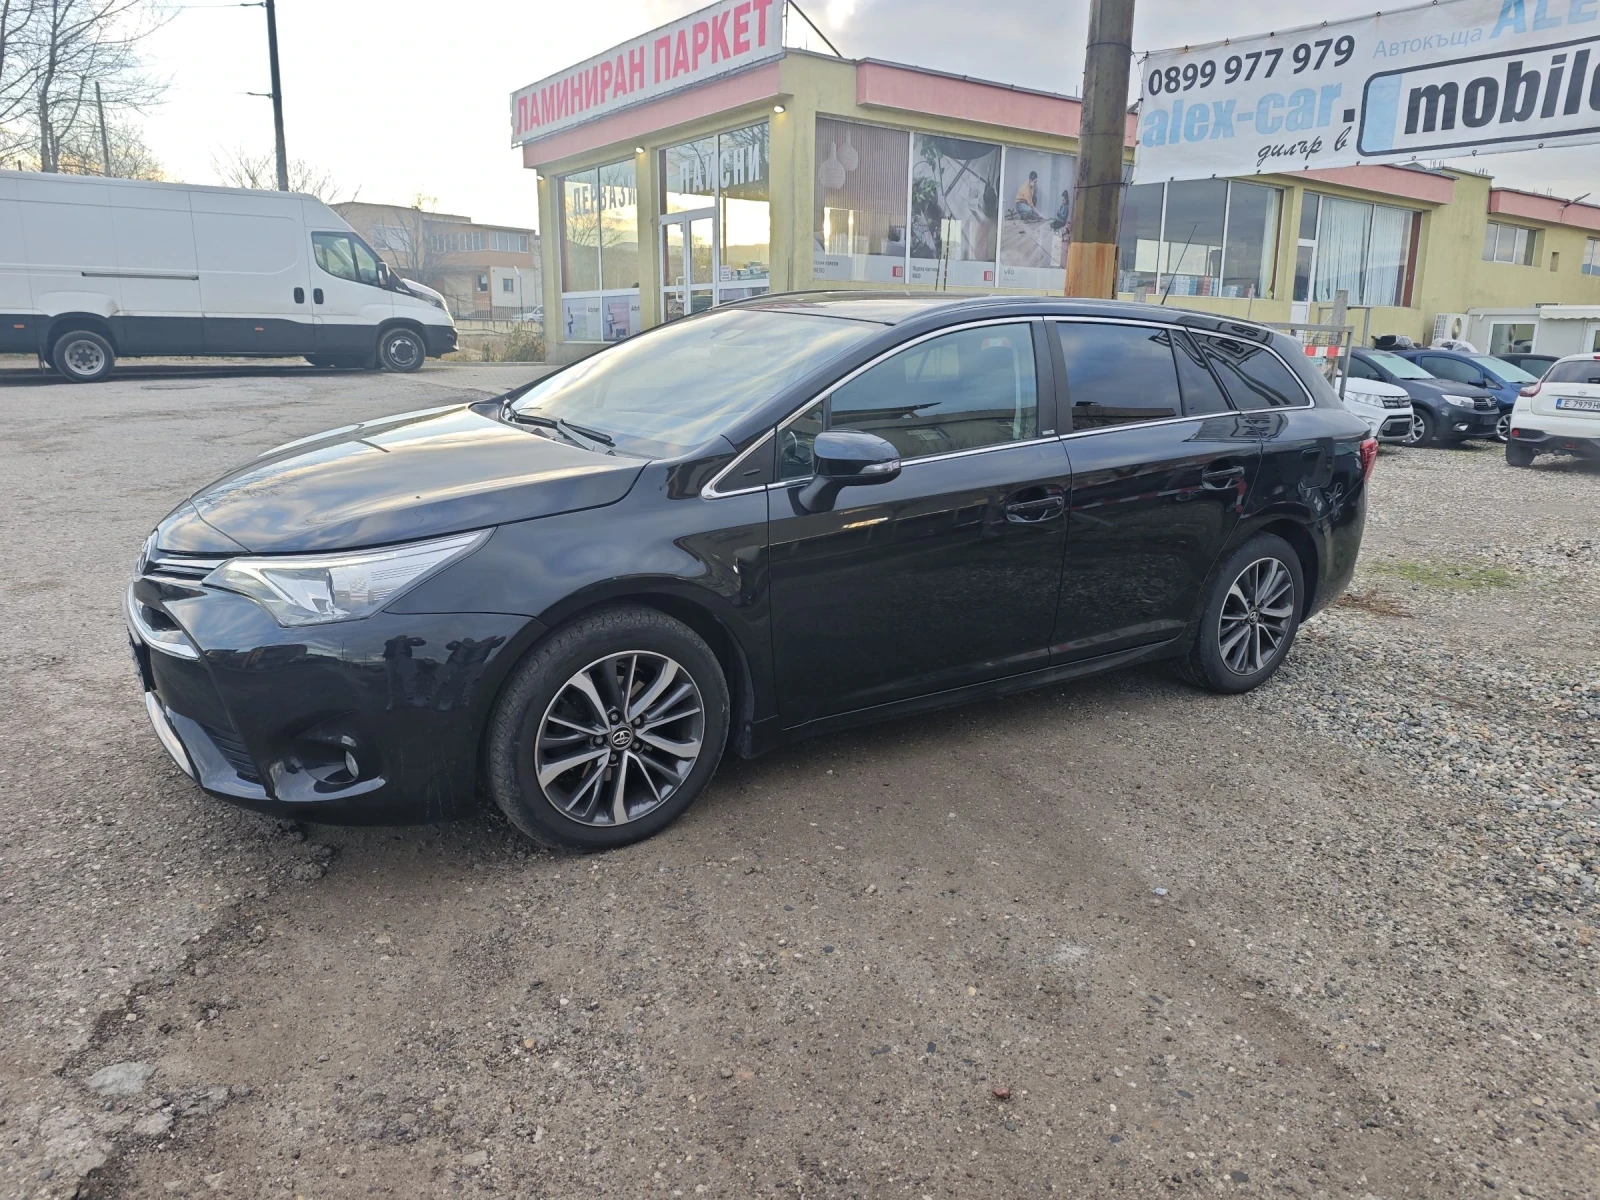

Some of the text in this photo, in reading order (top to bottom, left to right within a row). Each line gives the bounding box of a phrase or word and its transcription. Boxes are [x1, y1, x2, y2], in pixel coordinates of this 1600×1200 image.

[1372, 27, 1483, 60] Автокъща
[516, 0, 773, 135] ЛАМИНИРАН ПАРКЕТ
[1148, 35, 1355, 96] 0899 977 979
[1256, 125, 1352, 167] дилър в
[1573, 400, 1593, 410] 7979
